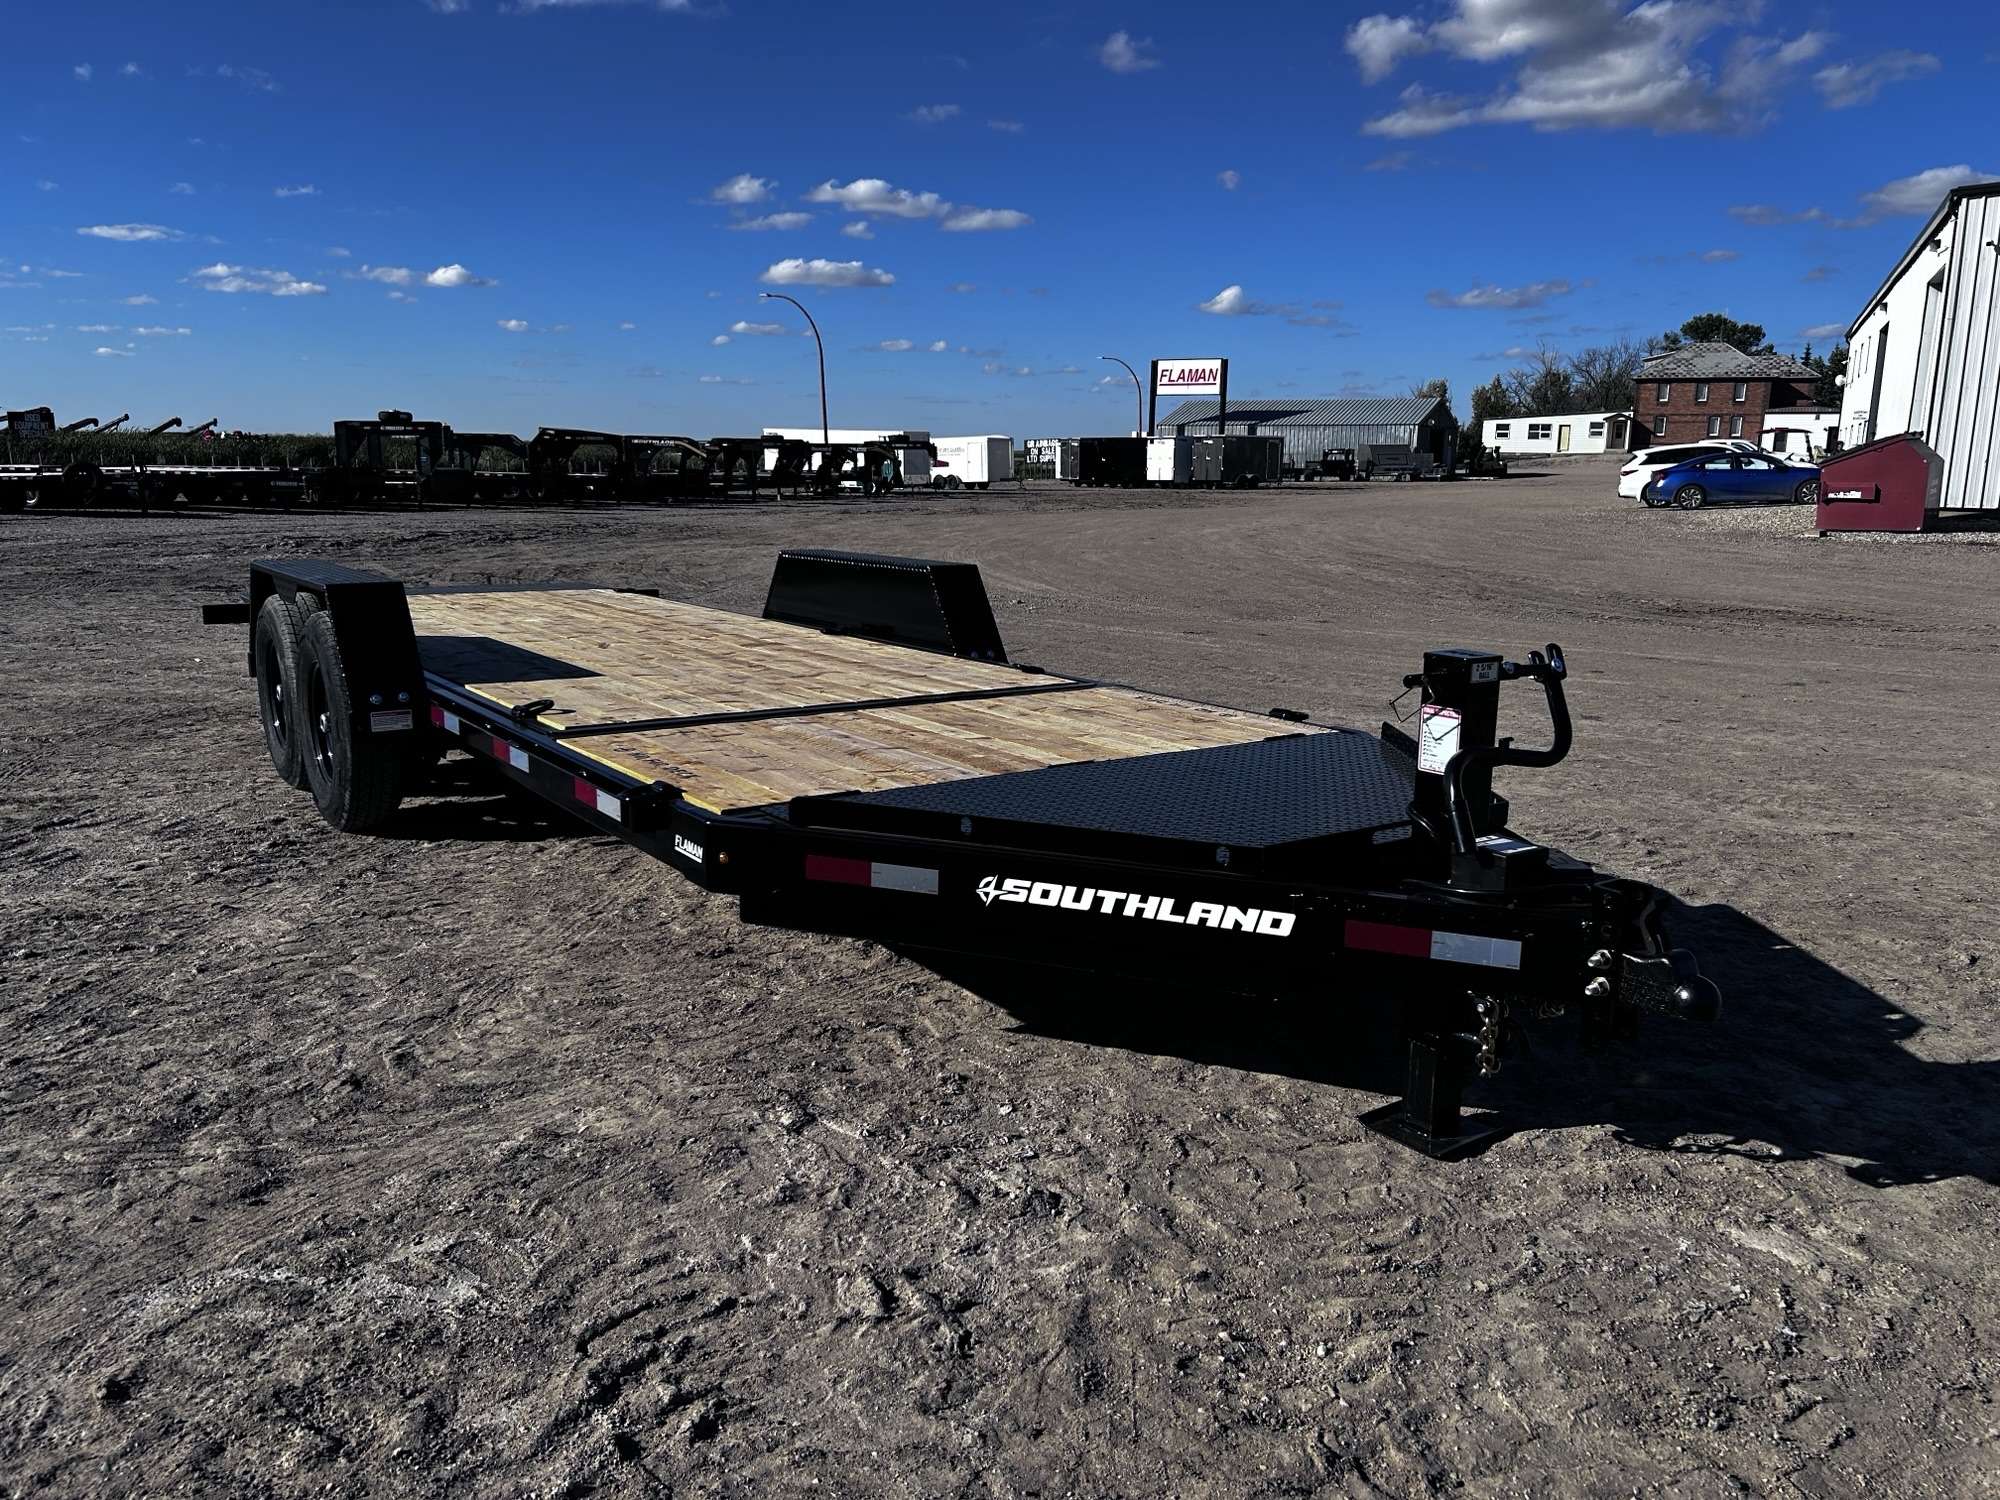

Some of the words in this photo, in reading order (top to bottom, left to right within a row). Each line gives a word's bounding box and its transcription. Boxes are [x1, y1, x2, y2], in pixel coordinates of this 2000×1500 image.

[1159, 368, 1218, 383] FLAMAN
[1041, 446, 1055, 455] SALE
[1026, 455, 1038, 463] LTD
[1039, 454, 1056, 463] SUPPL
[675, 834, 703, 859] FLAMAN
[999, 878, 1297, 937] SOUTHLAND
